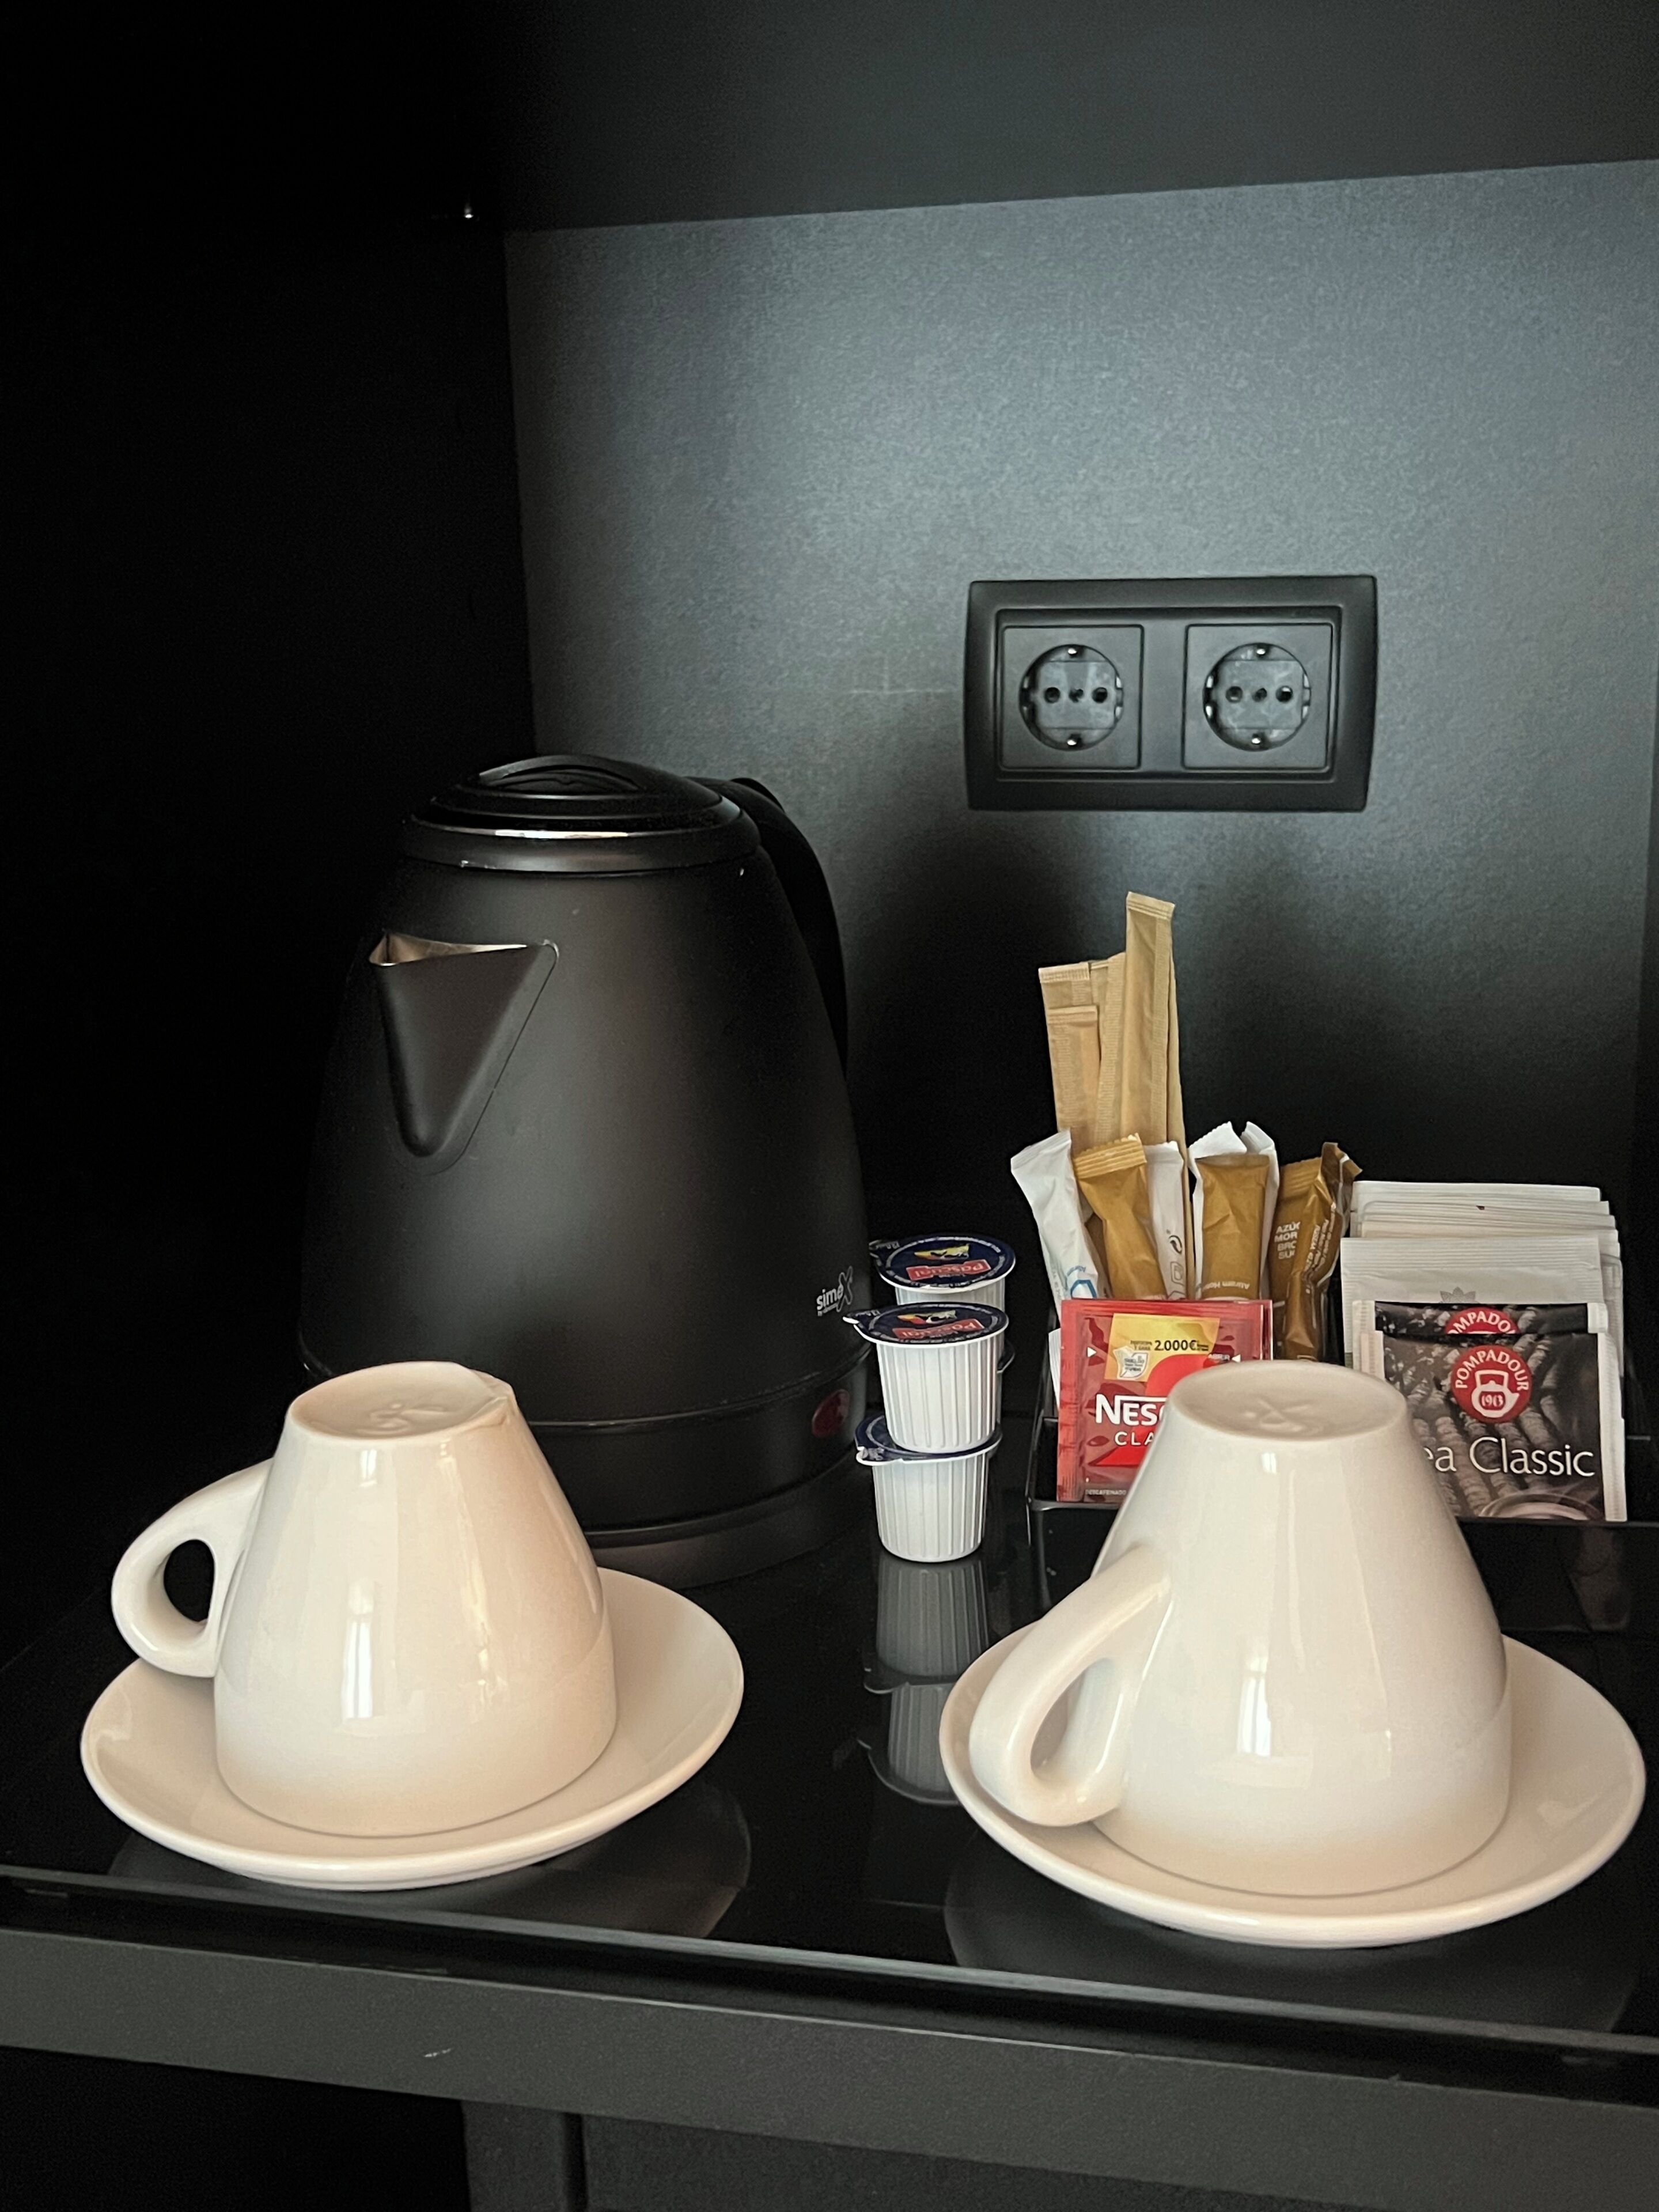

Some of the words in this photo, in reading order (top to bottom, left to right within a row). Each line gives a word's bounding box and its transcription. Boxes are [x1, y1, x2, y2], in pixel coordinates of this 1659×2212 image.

[915, 1263, 983, 1277] Pascual
[1448, 1311, 1516, 1334] MPADO
[1455, 1350, 1529, 1391] POMPADOUR
[1096, 1393, 1167, 1426] NES
[1469, 1437, 1595, 1476] Classic
